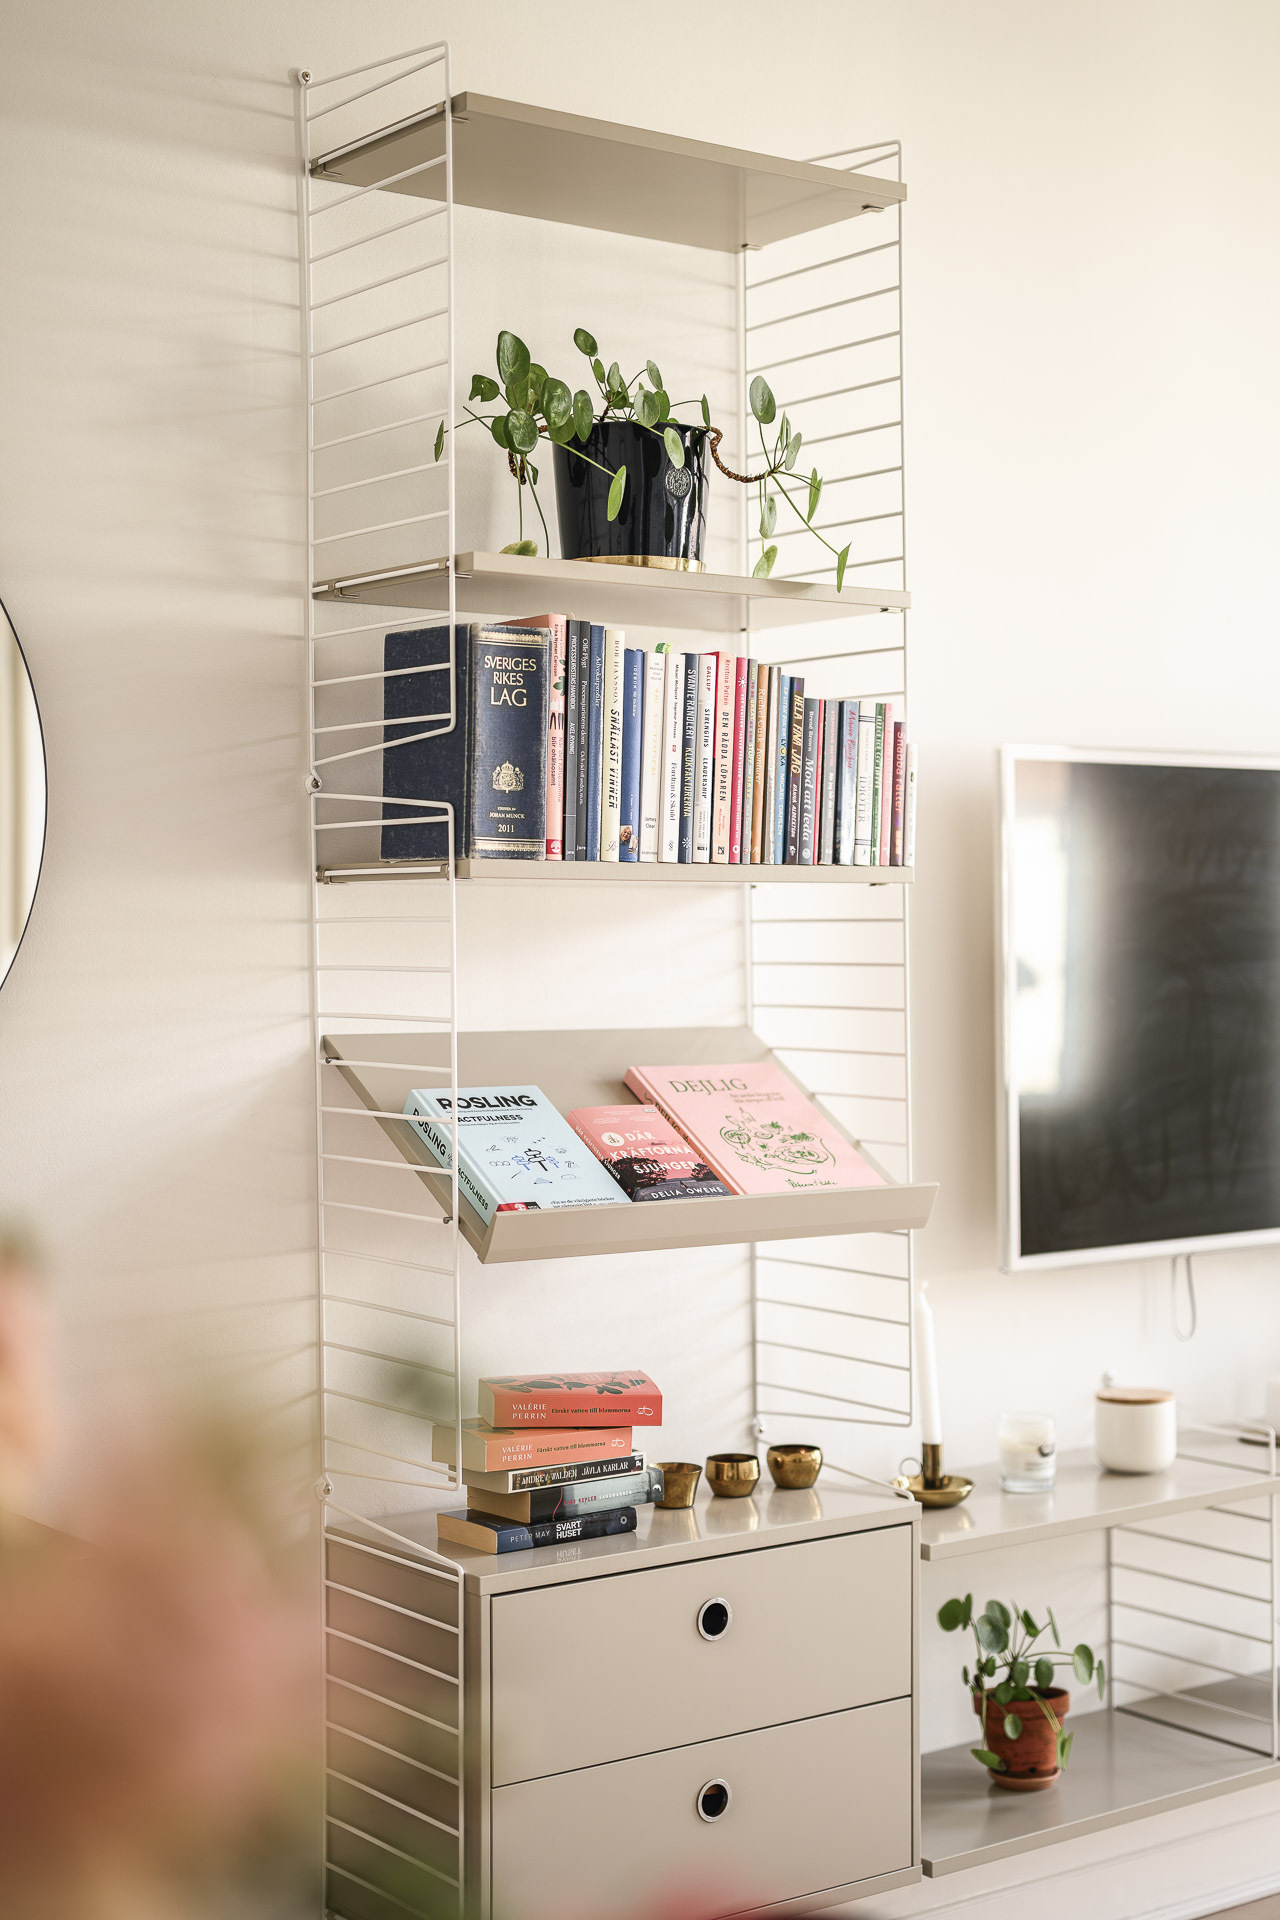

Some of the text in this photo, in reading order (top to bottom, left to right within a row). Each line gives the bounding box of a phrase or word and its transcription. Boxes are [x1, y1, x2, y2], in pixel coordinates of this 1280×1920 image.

[484, 655, 537, 671] SVERIGES
[493, 671, 524, 686] RIKES
[594, 655, 602, 707] Advokatprofiler
[490, 686, 527, 707] LAG
[580, 680, 588, 729] Processjuristens
[685, 669, 697, 740] SVANTE RANDLERT
[757, 688, 766, 743] Rachel Cusk
[703, 708, 711, 748] STRENGTHS
[791, 694, 803, 774] HELA FINA JAG
[720, 732, 729, 759] RÄDDA
[608, 709, 621, 809] SNÄLLAST VINNER
[683, 747, 694, 817] KLOKFAKTORERNA
[719, 764, 728, 801] LÖPAREN
[802, 757, 814, 841] Mod att leda
[858, 776, 867, 823] IDIOTER
[497, 824, 515, 833] 2011
[667, 1078, 748, 1096] DEJLIG
[436, 1095, 538, 1110] ROSLING
[450, 1114, 524, 1123] ACTFULNESS
[624, 1130, 656, 1141] DÄR
[583, 1135, 605, 1161] KRÄFTORNA
[603, 1159, 621, 1180] SJUNGER
[609, 1146, 695, 1161] KRÄFTORNA
[633, 1160, 700, 1175] SJUNGER
[457, 1165, 489, 1210] ACTFULNESS
[650, 1189, 683, 1199] DELIA
[686, 1186, 723, 1195] OWENS
[512, 1402, 547, 1411] VALÉRIE
[502, 1443, 533, 1454] VALÉRIE
[577, 1441, 606, 1449] blommorna
[502, 1453, 533, 1463] PERRIN
[550, 1468, 578, 1481] WALDEN
[581, 1464, 602, 1476] JÄVLA
[603, 1461, 629, 1474] KARLAR
[578, 1495, 597, 1504] KEPLER
[599, 1490, 633, 1500] SANDMANNEN
[556, 1520, 582, 1532] SVART
[556, 1528, 582, 1540] HUSET
[510, 1530, 551, 1543] PETER MAY
